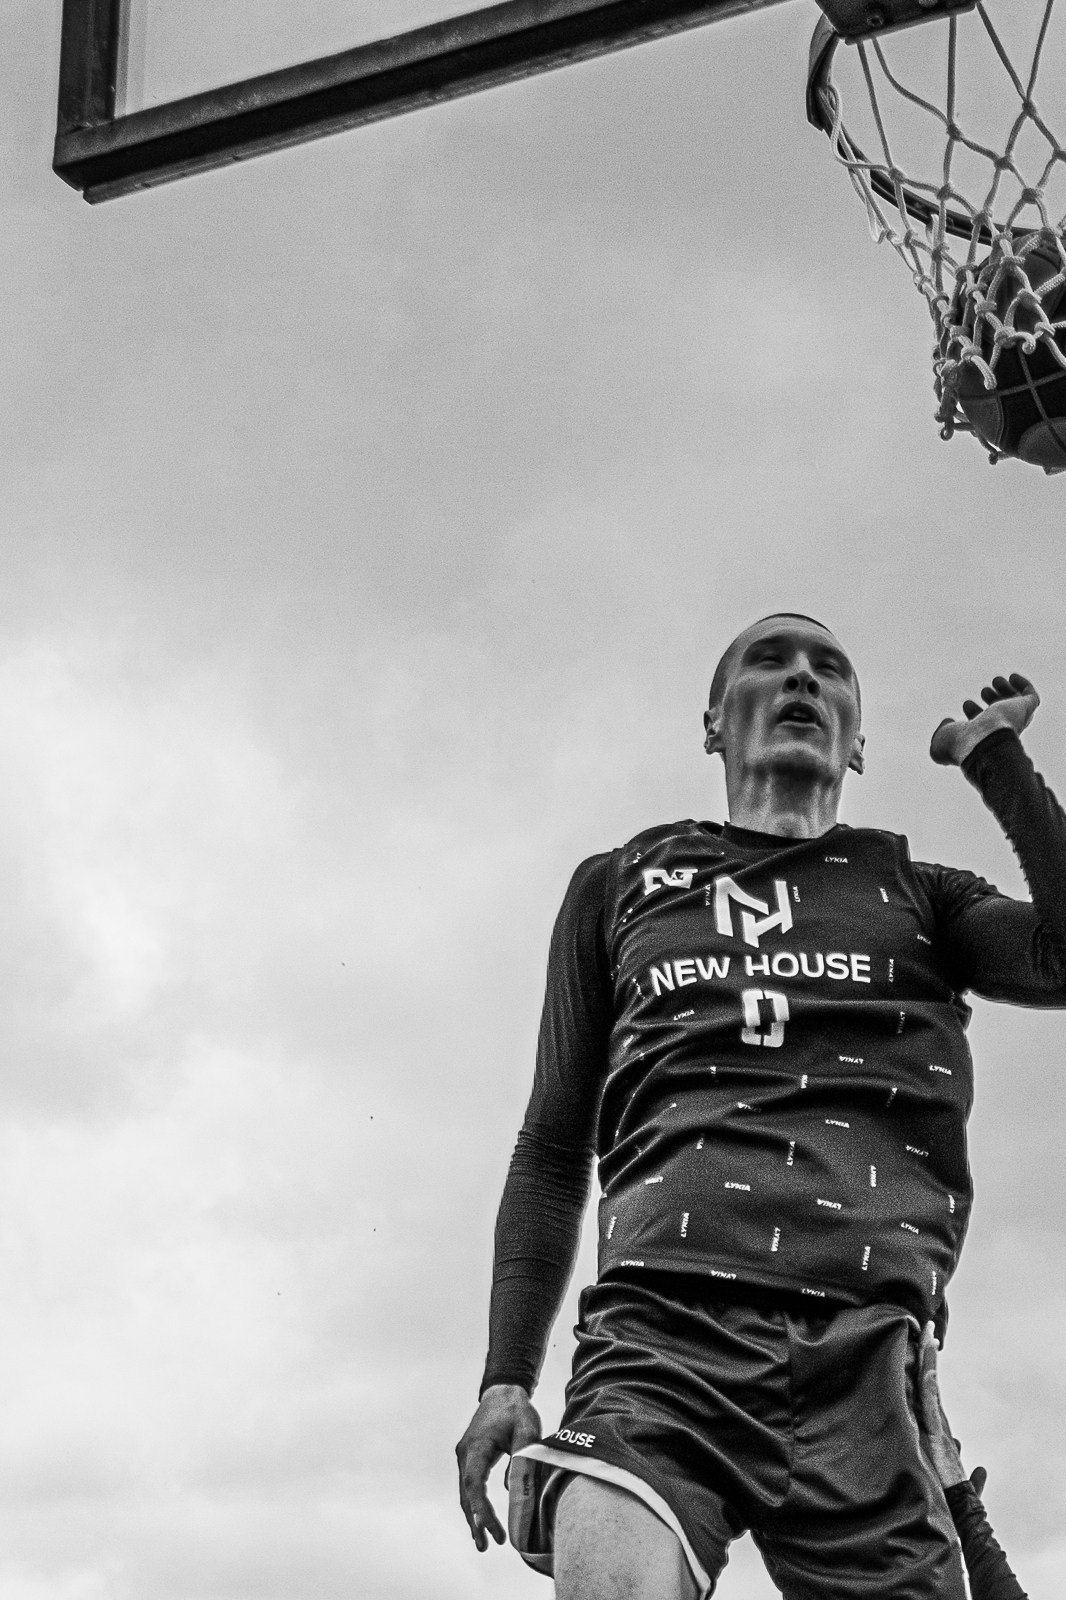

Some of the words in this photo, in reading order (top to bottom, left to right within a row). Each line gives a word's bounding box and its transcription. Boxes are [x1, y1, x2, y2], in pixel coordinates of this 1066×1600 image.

[650, 956, 731, 996] NEW
[745, 952, 871, 984] HOUSE
[741, 988, 790, 1048] 0
